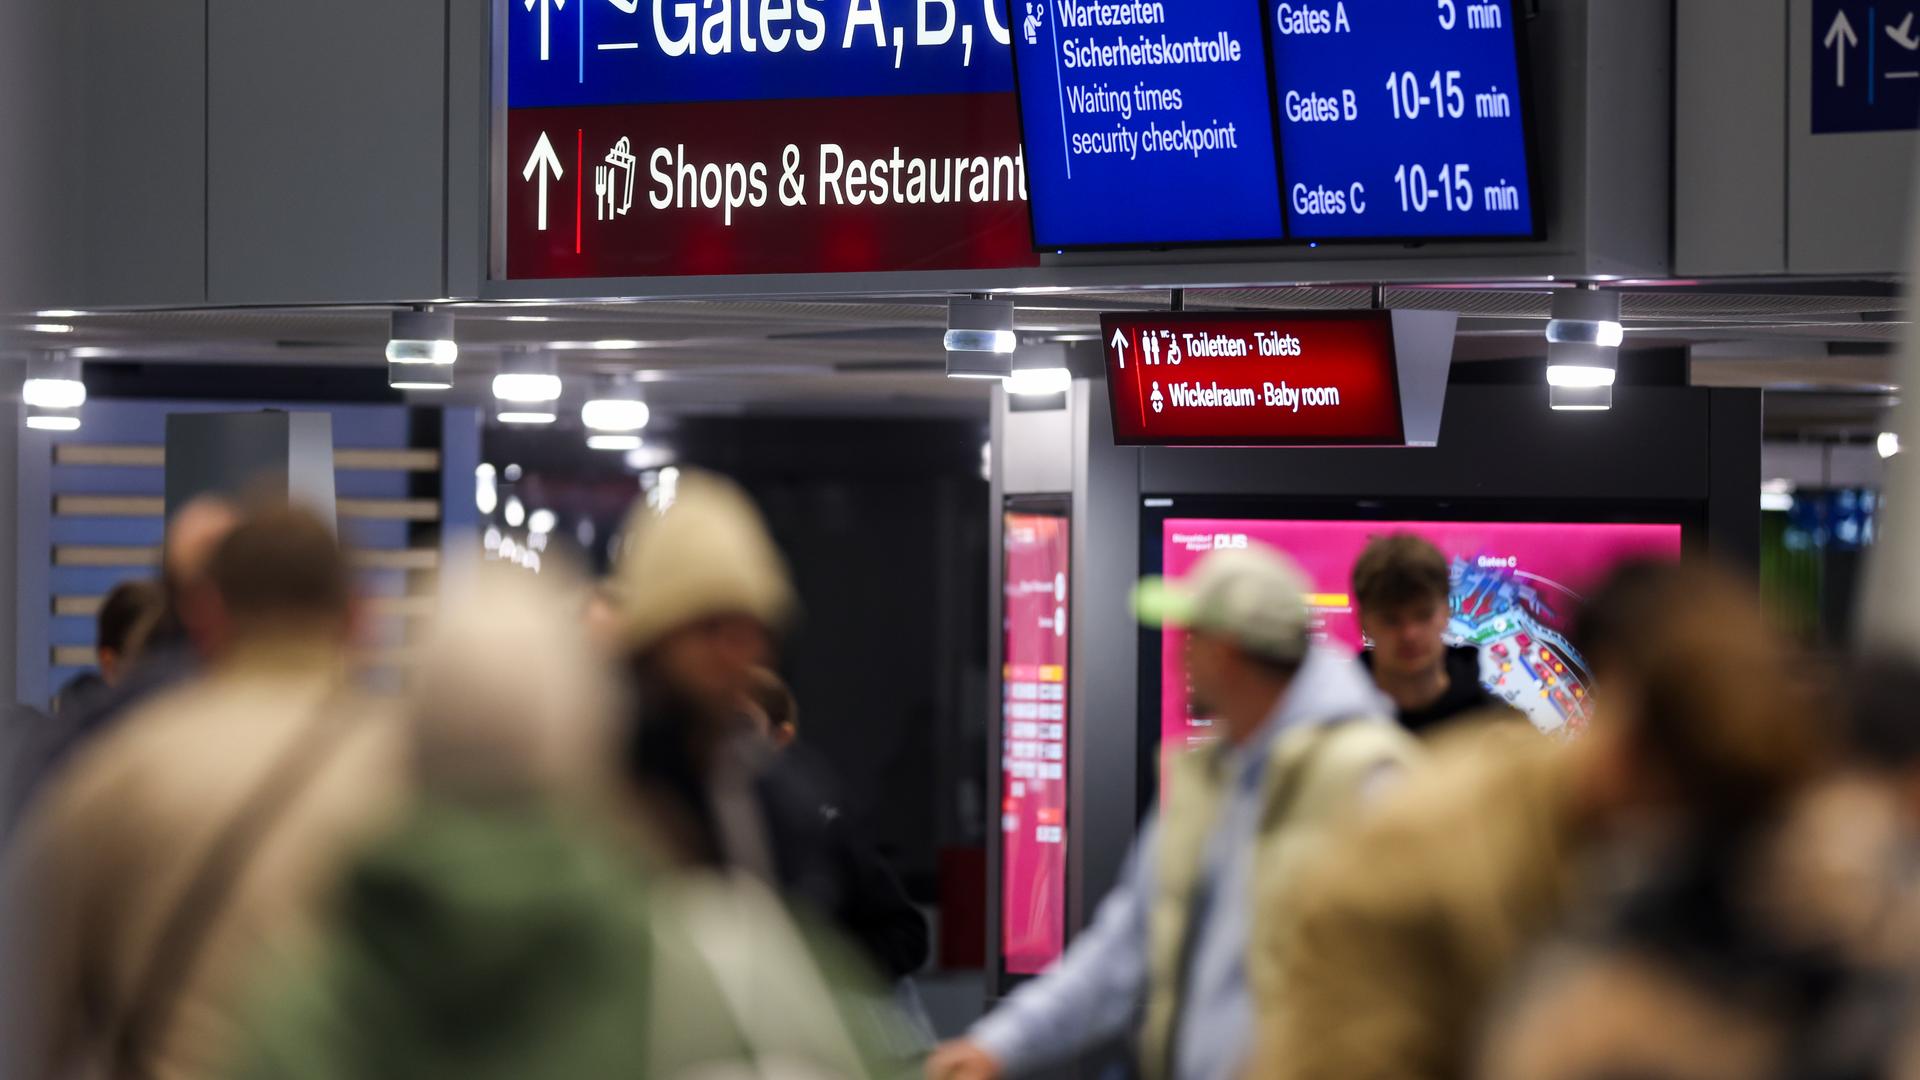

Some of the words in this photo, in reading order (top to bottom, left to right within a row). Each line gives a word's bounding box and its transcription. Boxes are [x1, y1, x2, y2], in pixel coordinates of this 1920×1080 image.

[652, 0, 826, 57] Gates
[1058, 0, 1165, 27] Wartezeiten
[1277, 2, 1331, 34] Gates
[1335, 1, 1350, 32] A
[1438, 0, 1456, 30] 5
[1467, 0, 1502, 29] min
[1063, 31, 1241, 68] Sicherheitskontrolle
[1066, 82, 1132, 120] Waiting
[1133, 81, 1183, 111] times
[1285, 90, 1339, 122] Gates
[1342, 89, 1357, 120] B
[1386, 70, 1464, 119] 10-15
[1475, 86, 1510, 118] min
[1072, 122, 1137, 161] security
[1142, 119, 1238, 158] checkpoint
[648, 143, 768, 226] Shops
[778, 143, 807, 206] &
[1292, 183, 1346, 214] Gates
[1349, 182, 1366, 214] C
[1394, 163, 1473, 212] 10-15
[1484, 178, 1519, 211] min
[1183, 332, 1247, 357] Toiletten
[1254, 331, 1301, 356] Toilets
[1168, 382, 1255, 407] Wickelraum
[1263, 381, 1300, 412] Baby
[1301, 387, 1339, 406] room
